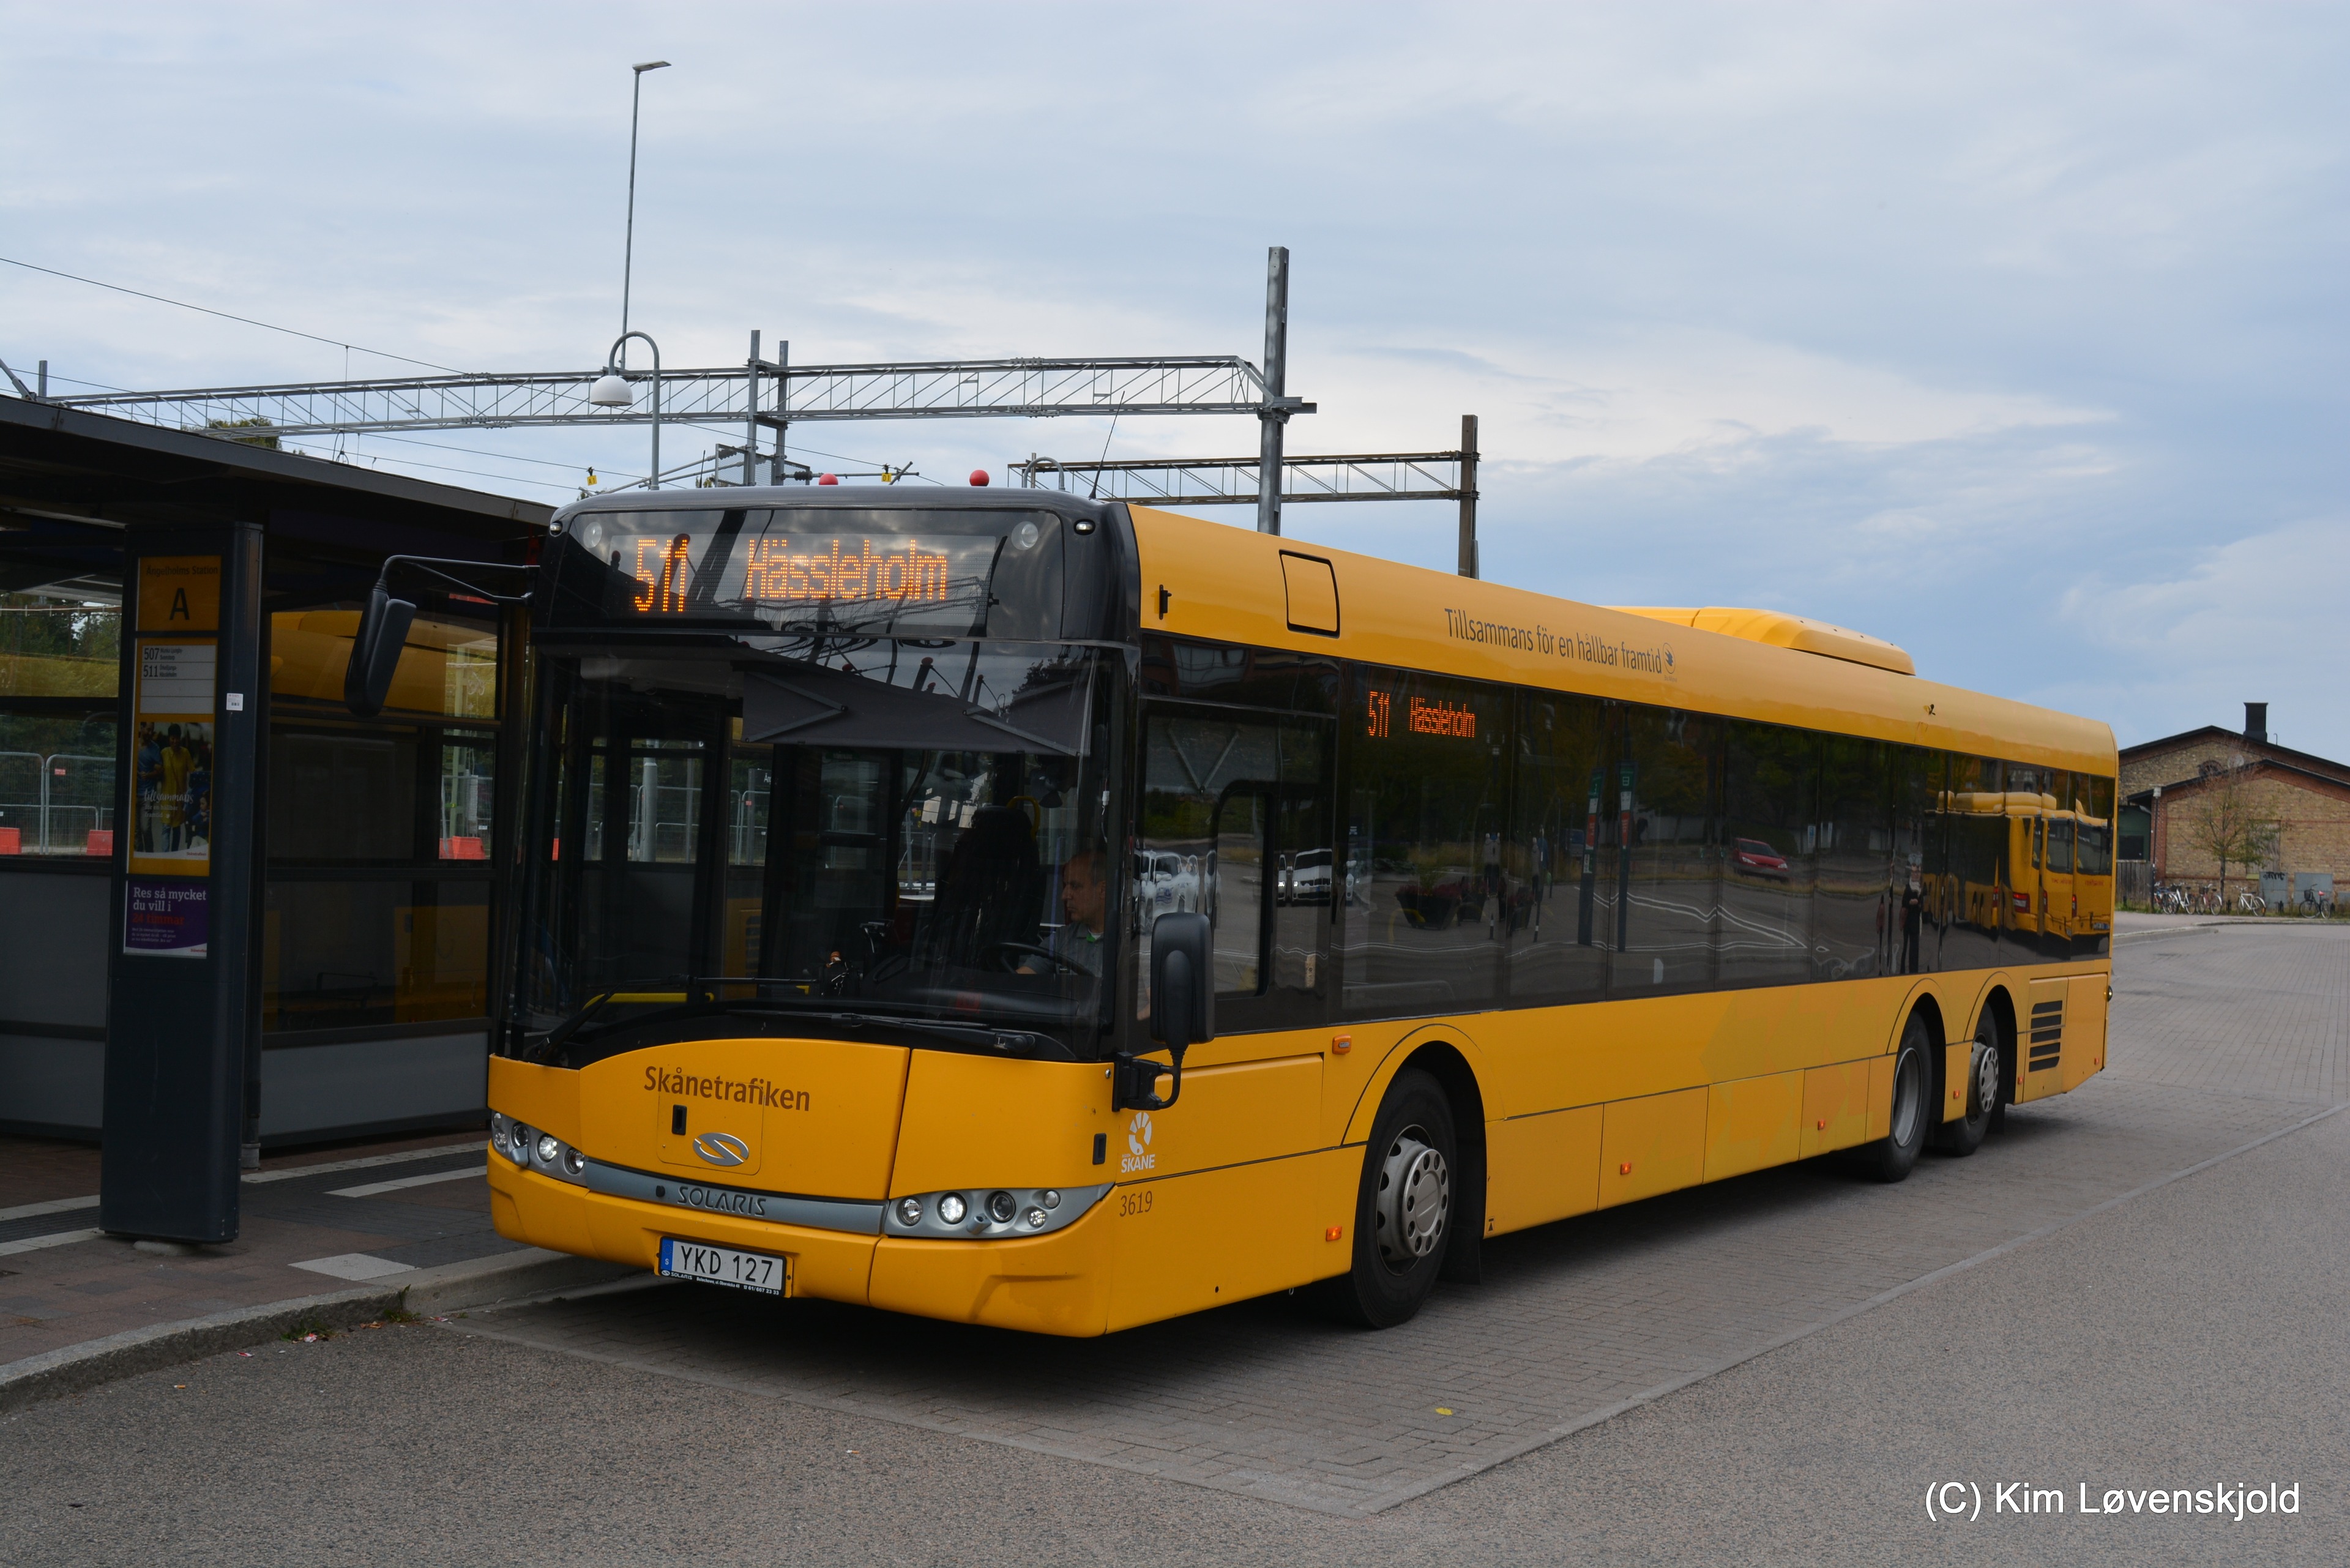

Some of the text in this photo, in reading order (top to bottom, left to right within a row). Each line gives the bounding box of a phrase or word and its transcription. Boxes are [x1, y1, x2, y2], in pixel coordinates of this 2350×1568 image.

[191, 566, 218, 575] Station
[635, 539, 948, 612] 511 Hässleholm
[169, 587, 190, 621] A
[144, 648, 160, 660] 507
[1444, 608, 1662, 674] Tillsammans för en hållbar framtid
[143, 665, 159, 678] 511
[1368, 691, 1475, 738] 511 Hässleholm
[133, 887, 206, 902] Res så mycket
[133, 899, 171, 912] du vill i
[146, 914, 185, 926] timmar
[644, 1066, 810, 1112] Skånetrafiken
[677, 1185, 767, 1217] SOLARIS
[1119, 1190, 1152, 1217] 3619
[671, 1272, 693, 1280] SOLARIS
[681, 1245, 774, 1284] YKD 127
